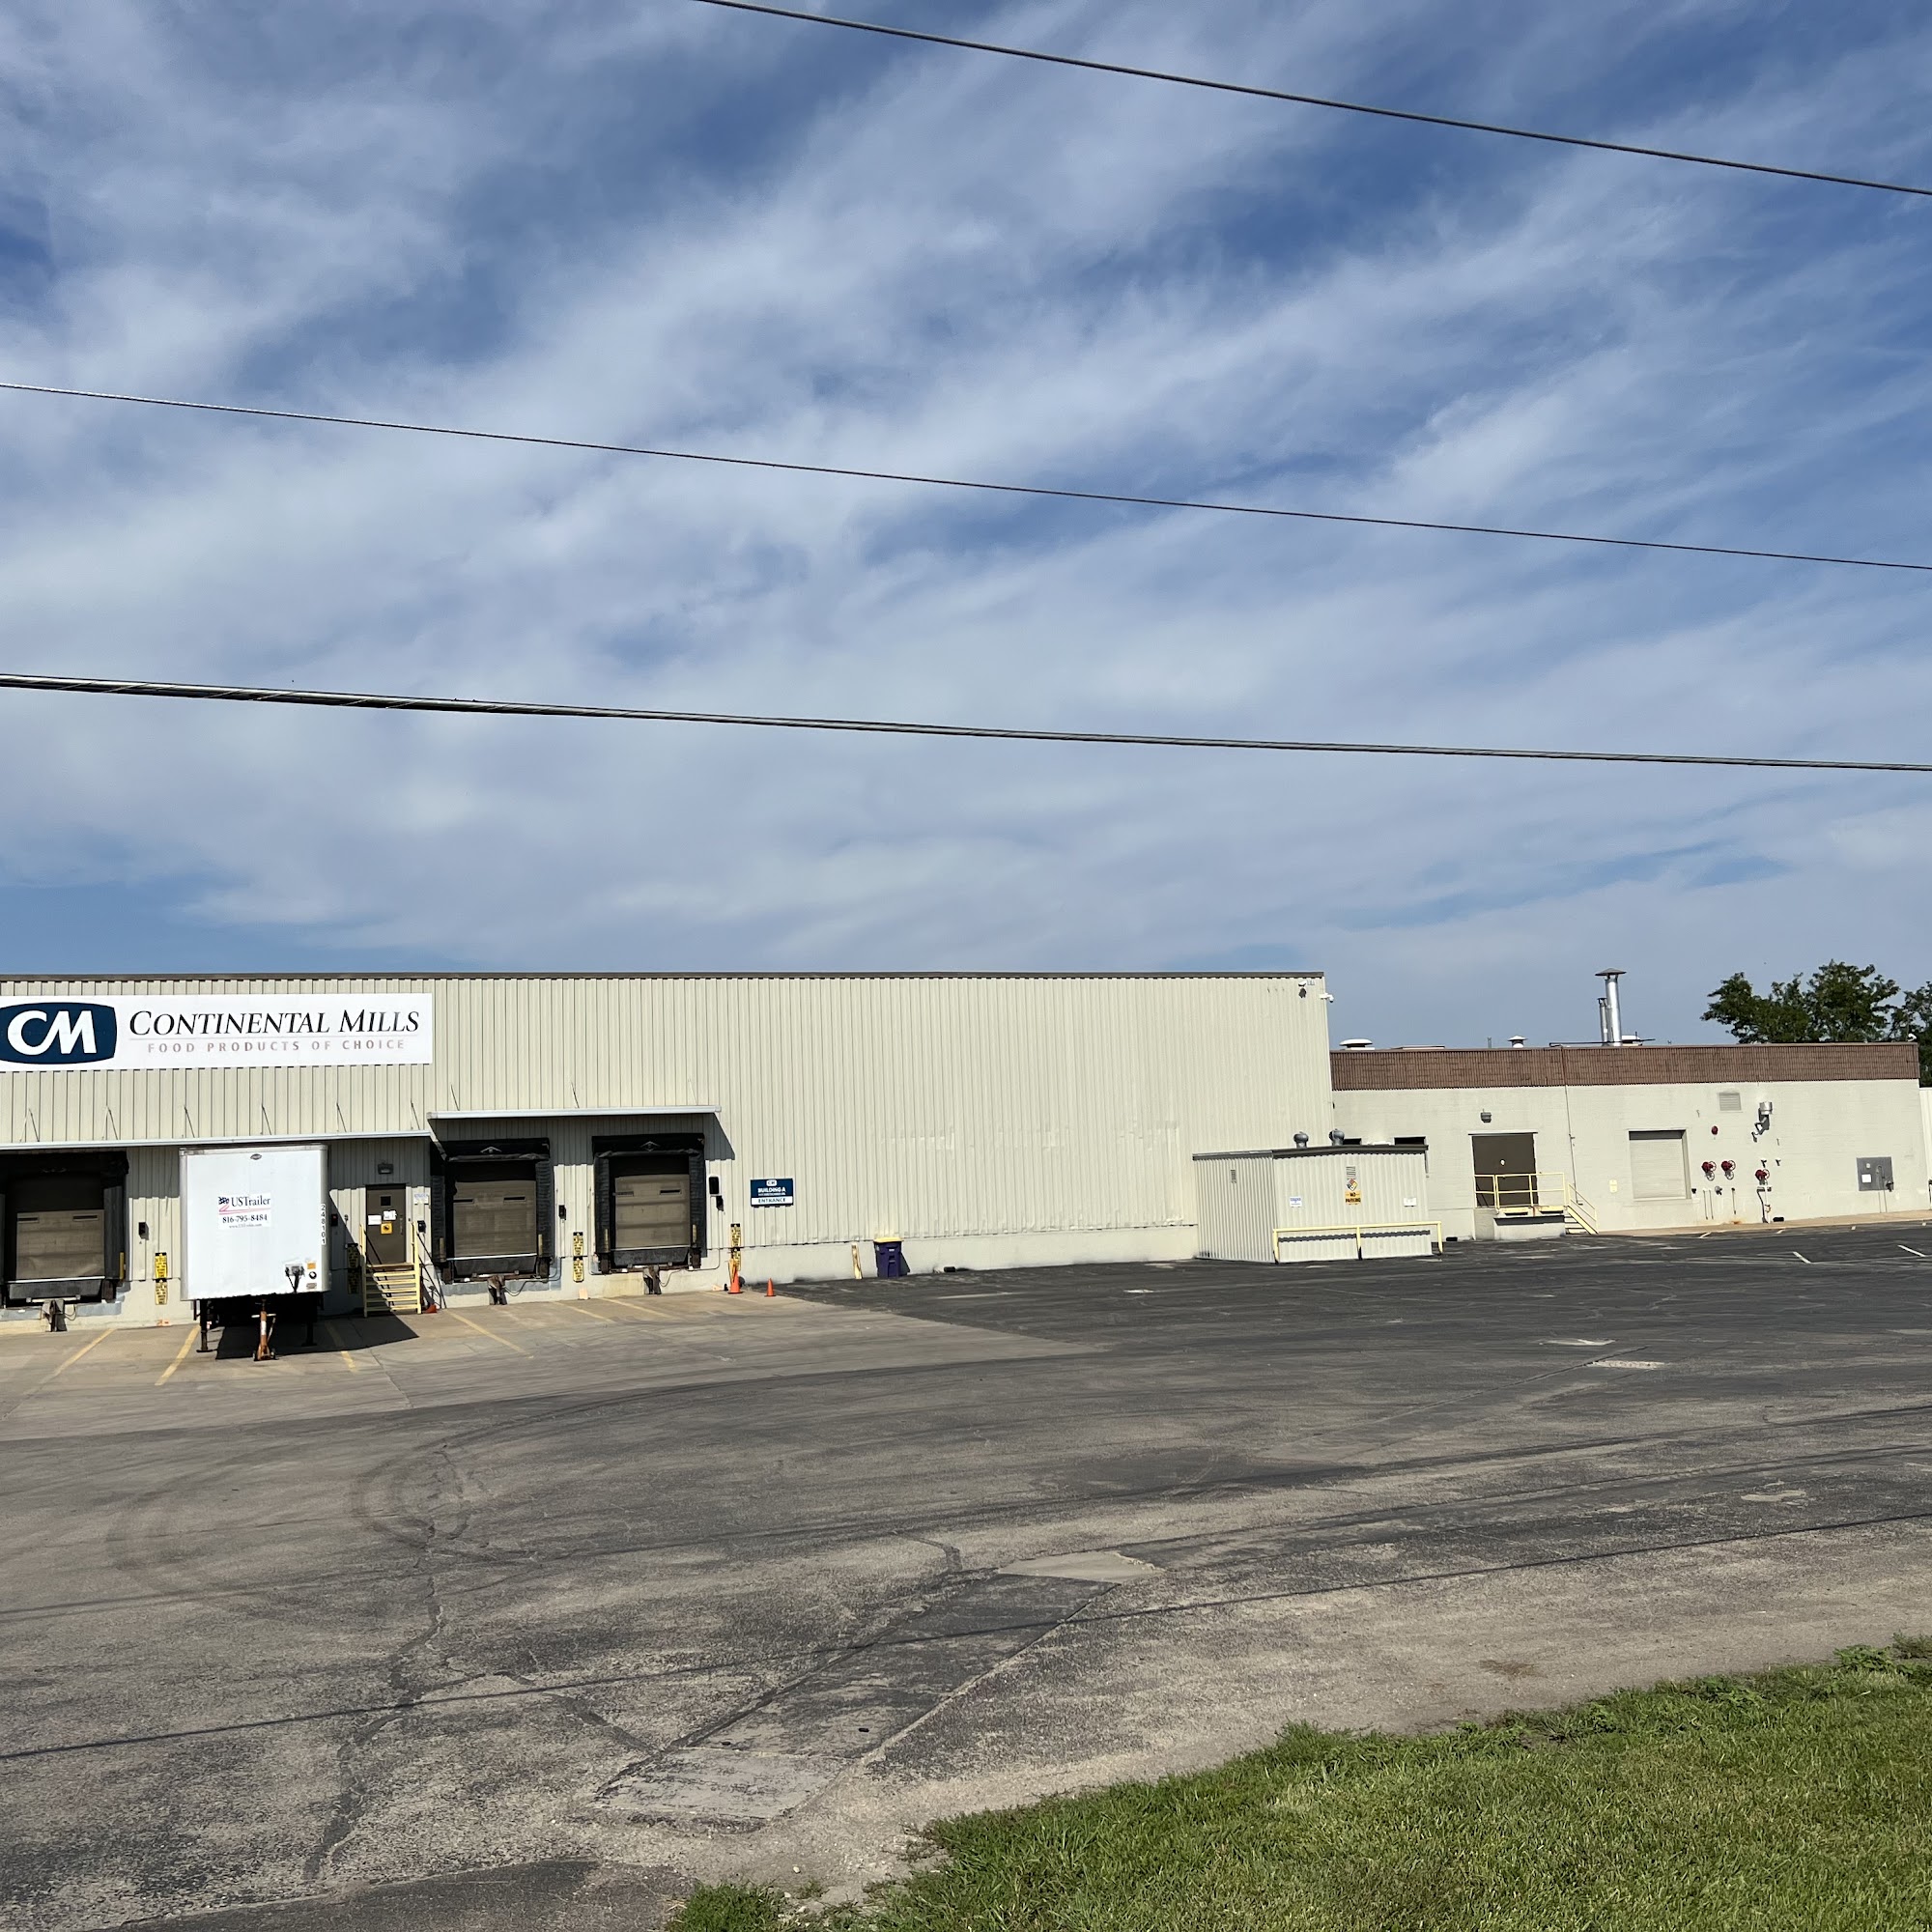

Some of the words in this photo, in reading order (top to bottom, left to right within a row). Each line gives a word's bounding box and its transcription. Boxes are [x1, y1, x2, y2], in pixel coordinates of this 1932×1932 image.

[8, 1009, 98, 1056] CM
[129, 1010, 330, 1036] CONTINENTAL
[338, 1009, 419, 1033] MILLS
[148, 1042, 195, 1053] FOOD
[207, 1040, 299, 1053] PRODUCTS
[311, 1040, 331, 1051] OF
[342, 1038, 405, 1050] CHOICE
